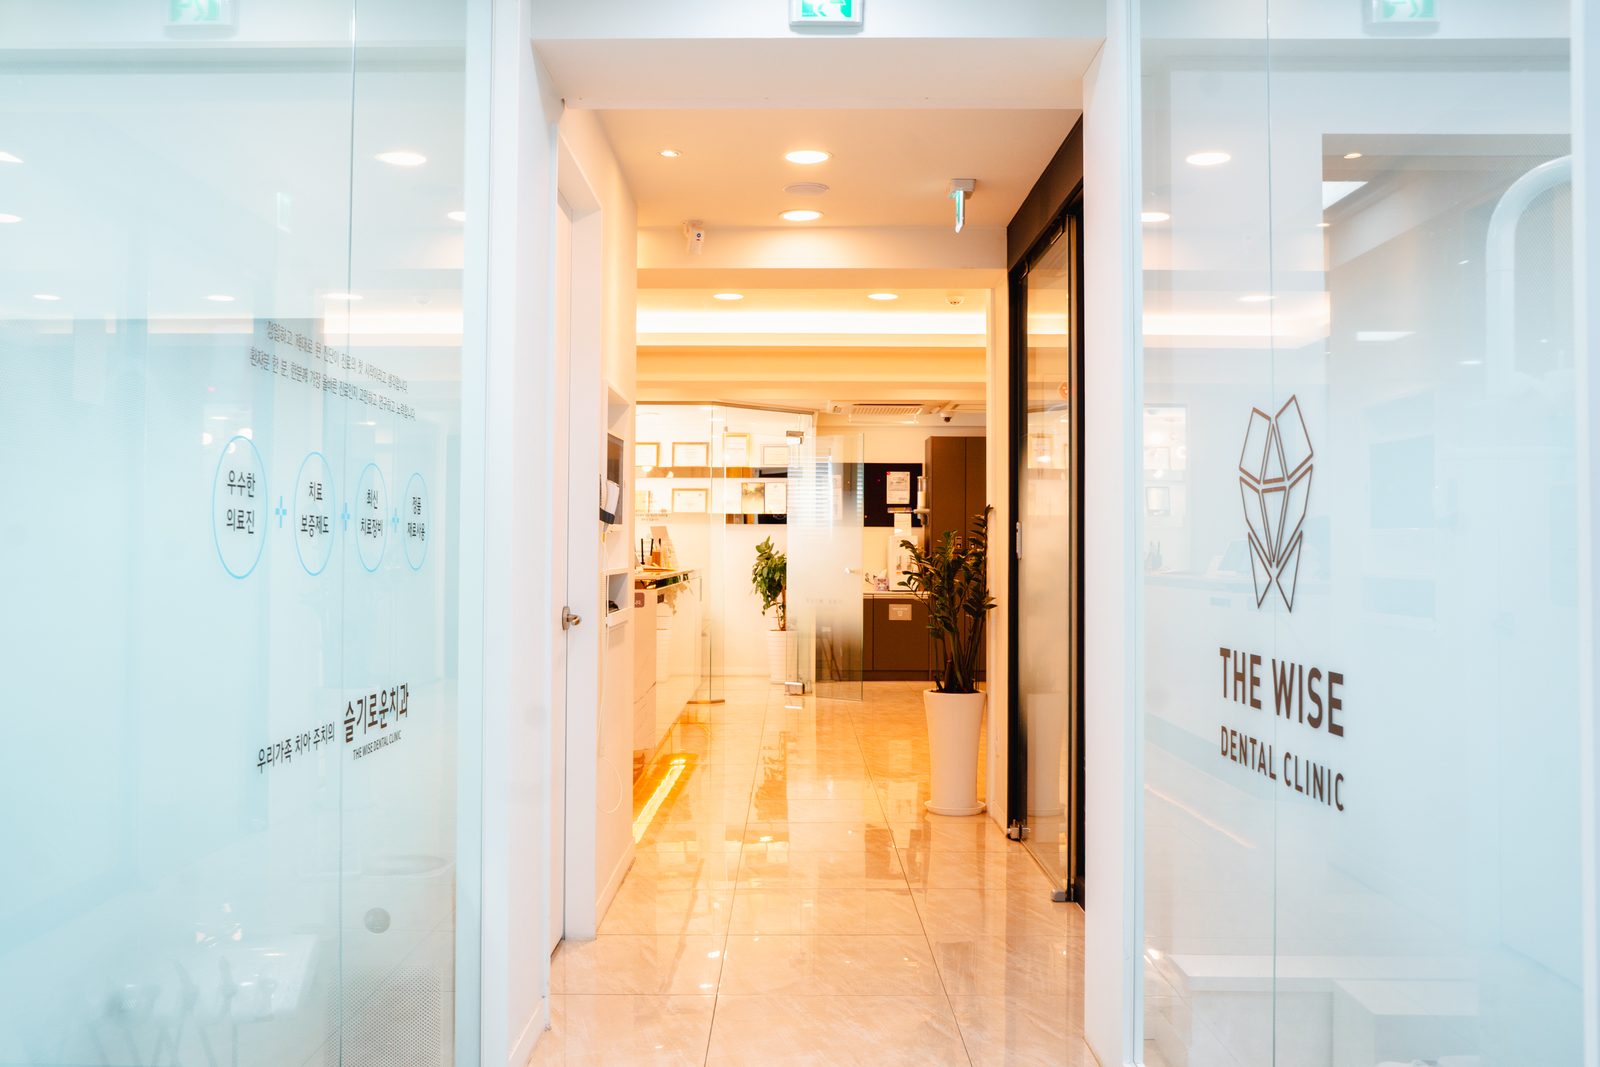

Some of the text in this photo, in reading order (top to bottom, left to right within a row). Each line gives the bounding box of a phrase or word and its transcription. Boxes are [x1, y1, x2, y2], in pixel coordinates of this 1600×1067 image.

[272, 354, 279, 374] 한
[227, 470, 256, 498] 우수한
[309, 481, 323, 501] 치료
[366, 489, 379, 509] 최신
[226, 508, 255, 534] 의료진
[301, 514, 329, 538] 보증제도
[360, 518, 383, 539] 치료장비
[1220, 647, 1344, 737] THE WISE
[257, 682, 409, 774] 우리가족 치아 주치의 슬기로운치과
[353, 730, 402, 760] THE WISE DENTAL CLINIC
[1220, 725, 1344, 812] DENTAL CLINIC
